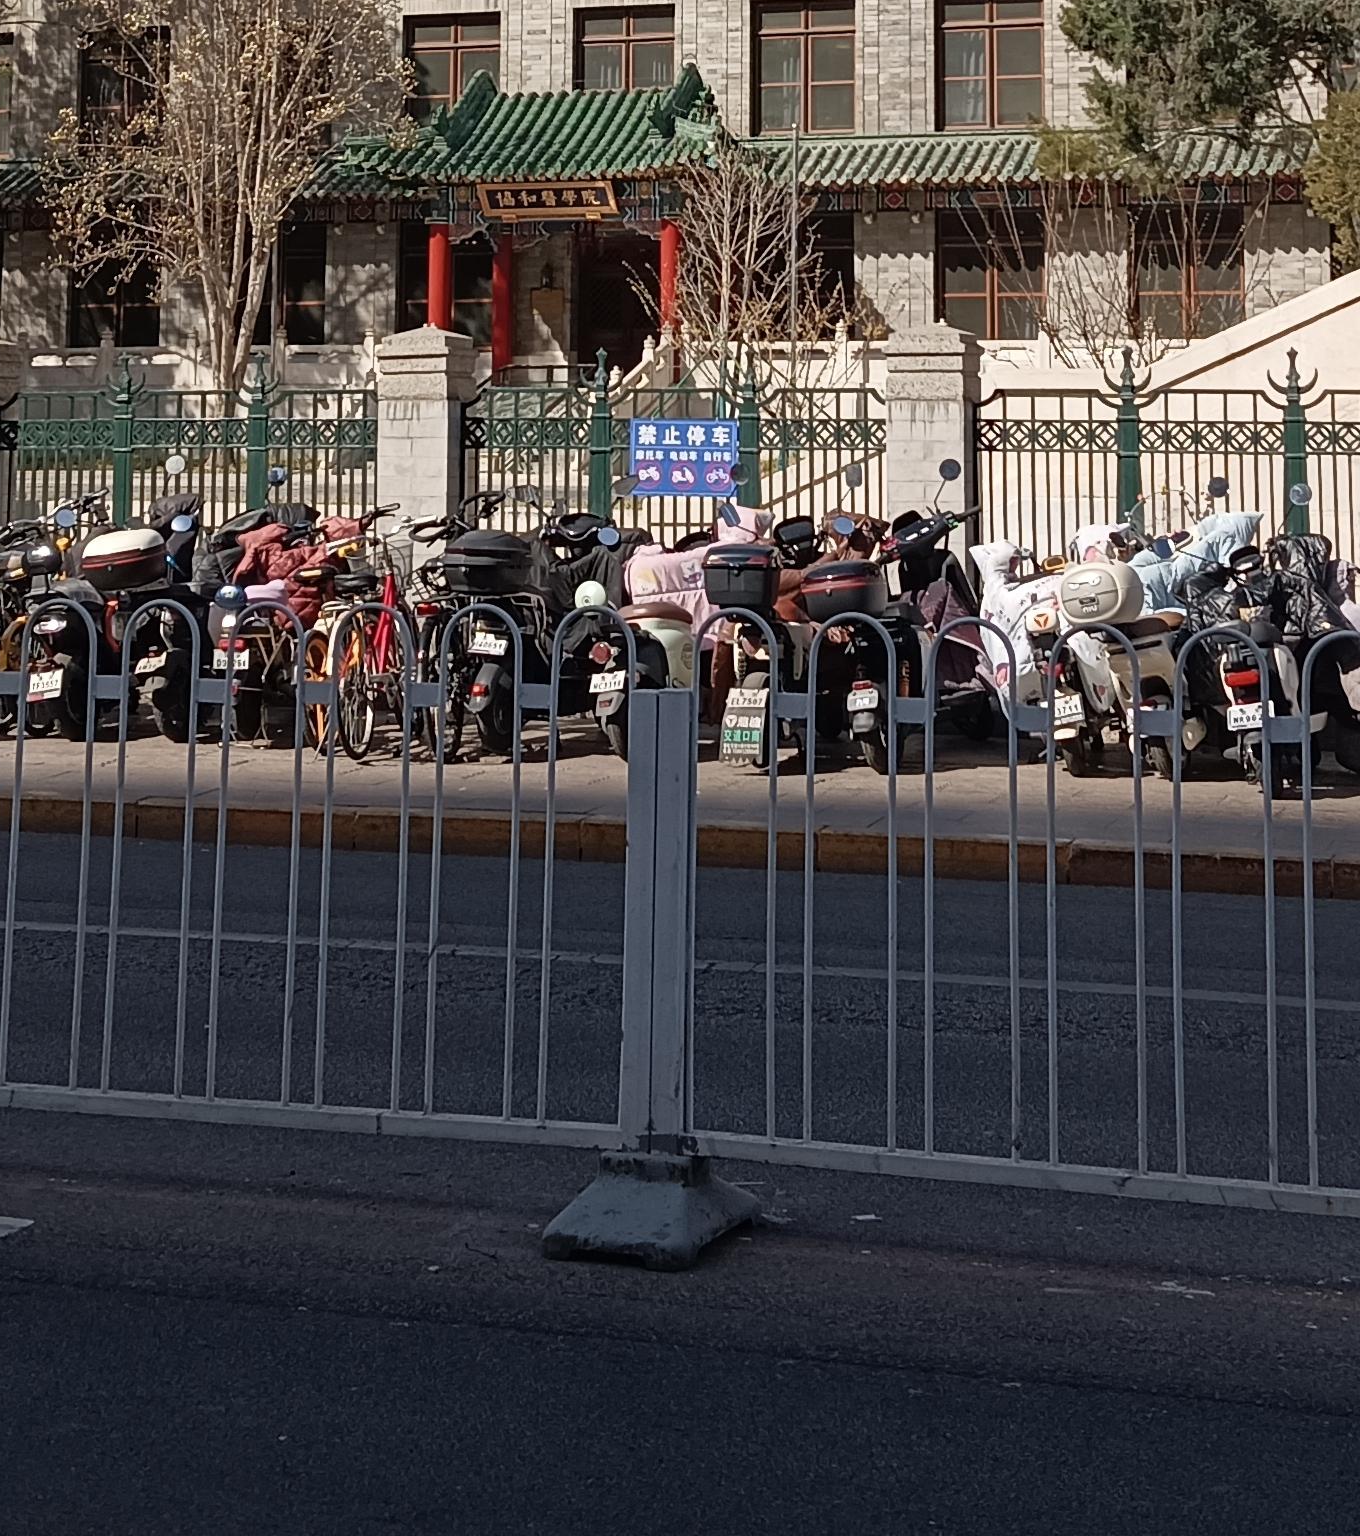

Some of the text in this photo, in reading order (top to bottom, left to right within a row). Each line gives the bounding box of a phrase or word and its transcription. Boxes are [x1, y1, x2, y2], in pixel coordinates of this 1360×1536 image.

[495, 189, 601, 208] 協和醫學院
[638, 424, 731, 447] 禁止停车
[635, 449, 732, 462] 摩托车 电动车 自行车
